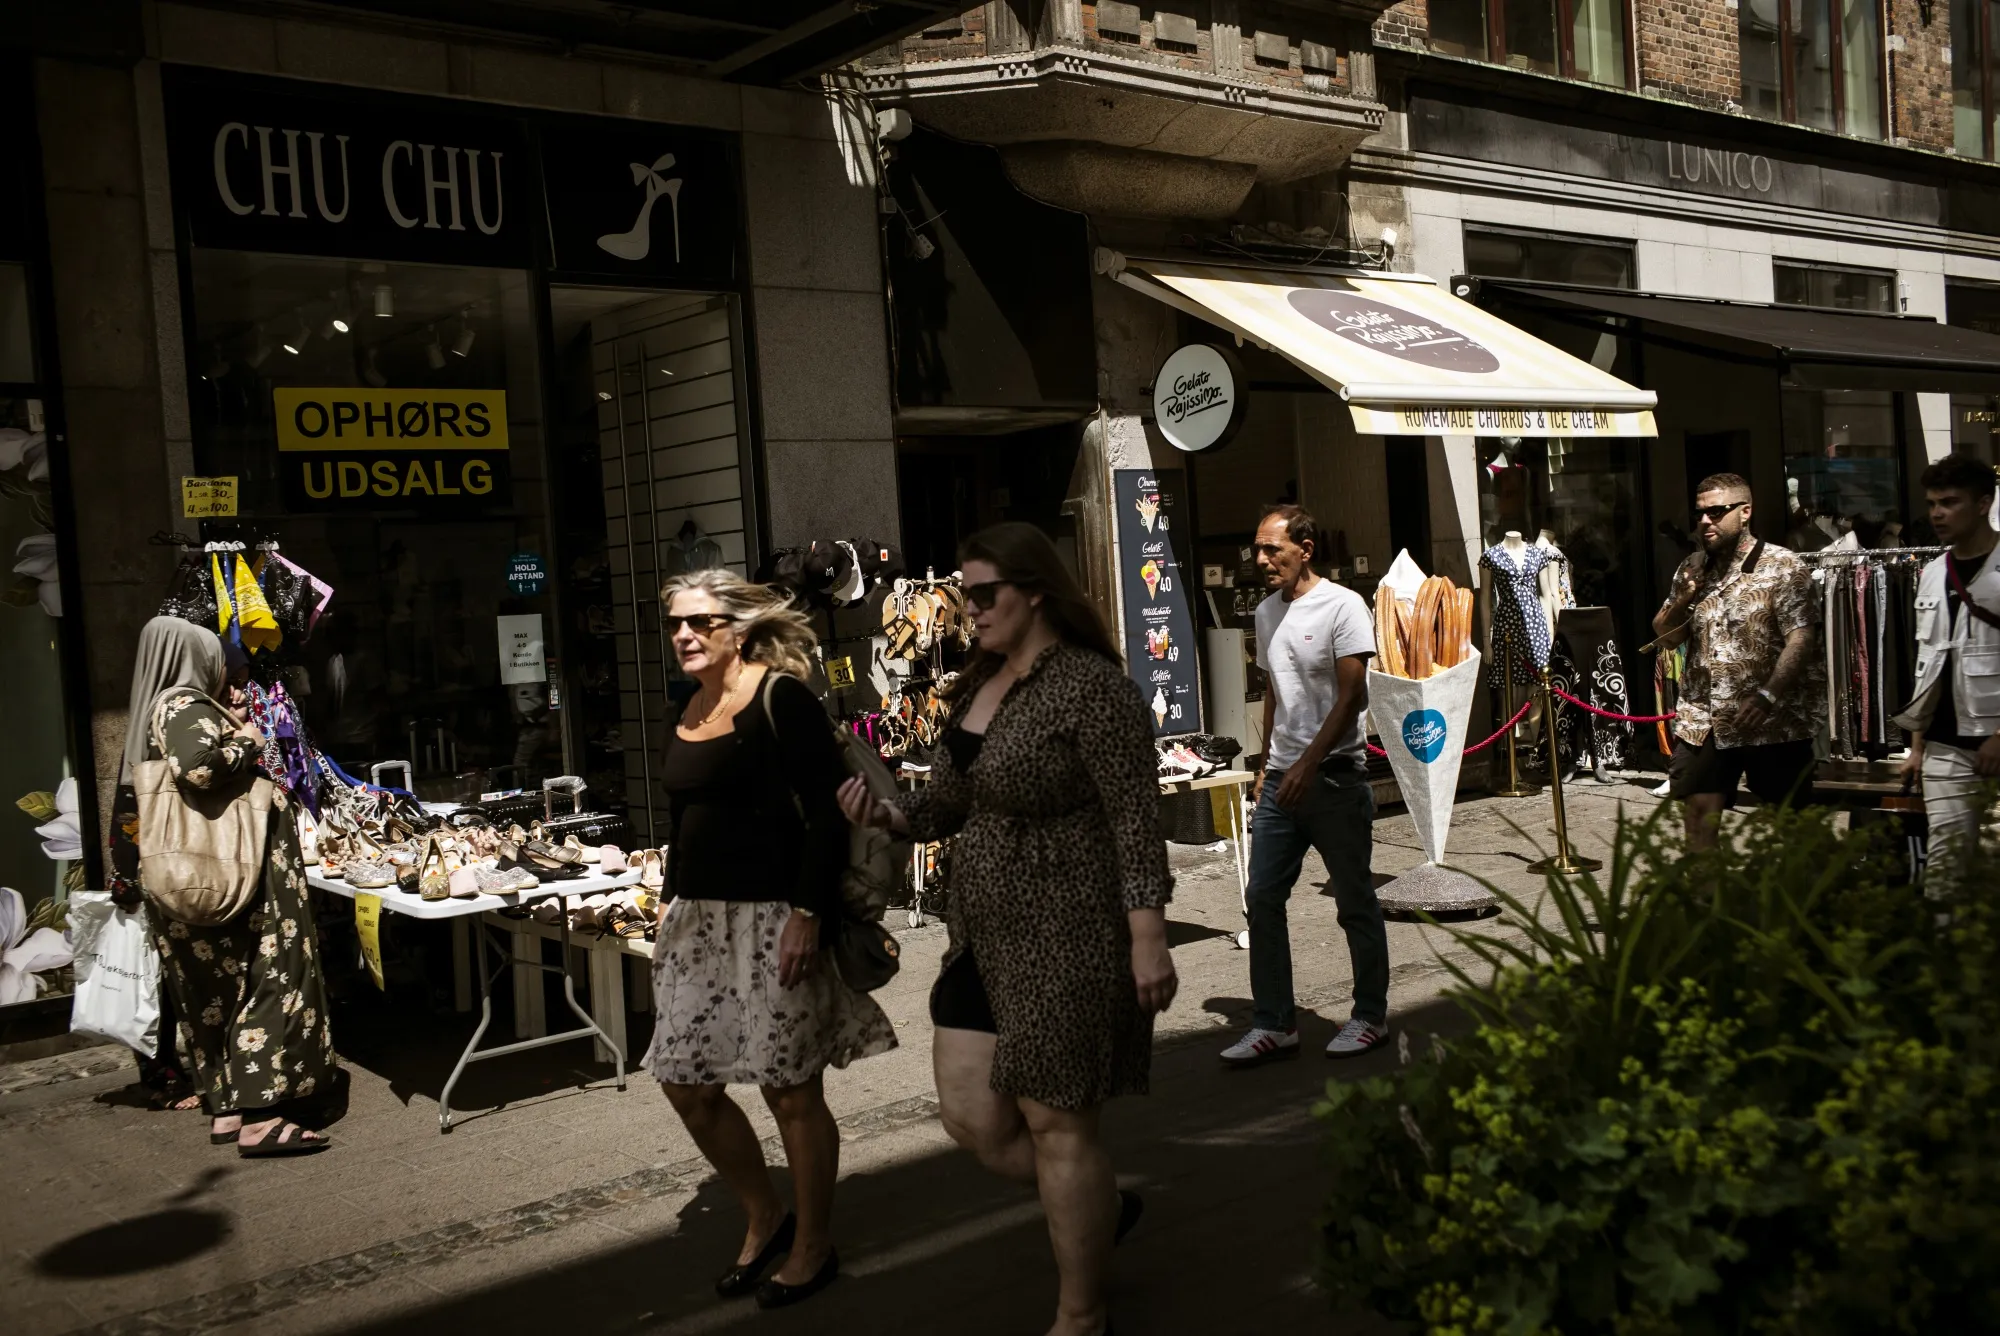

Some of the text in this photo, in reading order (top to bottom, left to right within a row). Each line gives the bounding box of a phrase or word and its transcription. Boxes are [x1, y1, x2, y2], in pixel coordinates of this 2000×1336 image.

[213, 121, 504, 235] CHU CHU
[1173, 370, 1211, 396] Gelato
[294, 401, 492, 439] OPHØRS
[1404, 407, 1610, 429] HOMEMADE CHURROS & ICE CREAM
[302, 459, 494, 499] UDSALG
[1158, 515, 1169, 532] 48
[509, 572, 545, 580] AFSTAND
[1160, 576, 1172, 592] 40
[1168, 646, 1179, 662] 49
[834, 667, 850, 682] 30
[1170, 703, 1182, 719] 30
